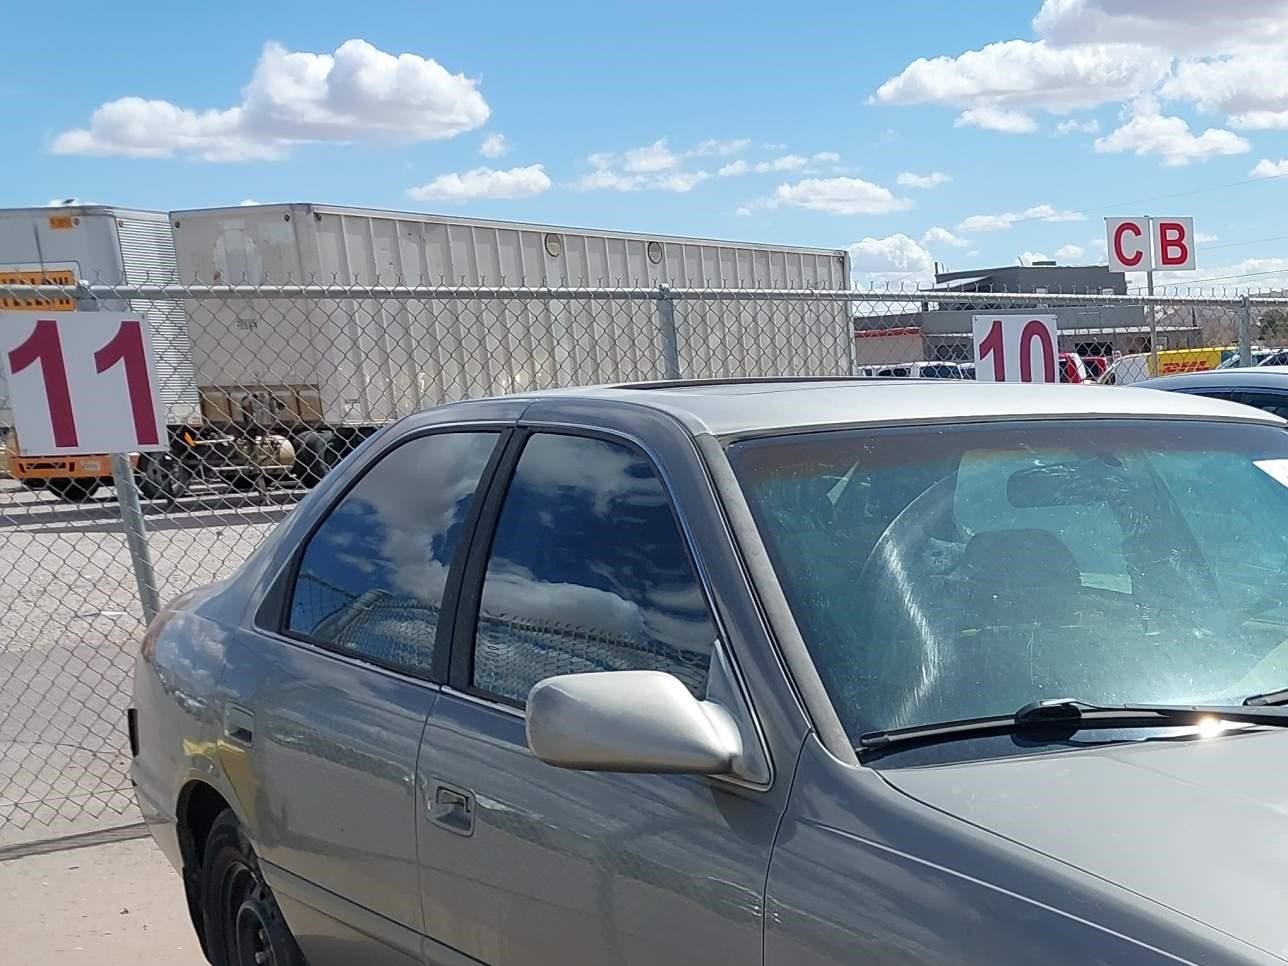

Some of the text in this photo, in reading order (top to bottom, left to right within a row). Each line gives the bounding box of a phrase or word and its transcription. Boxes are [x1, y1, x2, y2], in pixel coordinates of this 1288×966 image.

[1114, 222, 1143, 267] C
[1159, 222, 1189, 266] B
[979, 320, 1056, 382] 10
[7, 319, 160, 448] 11
